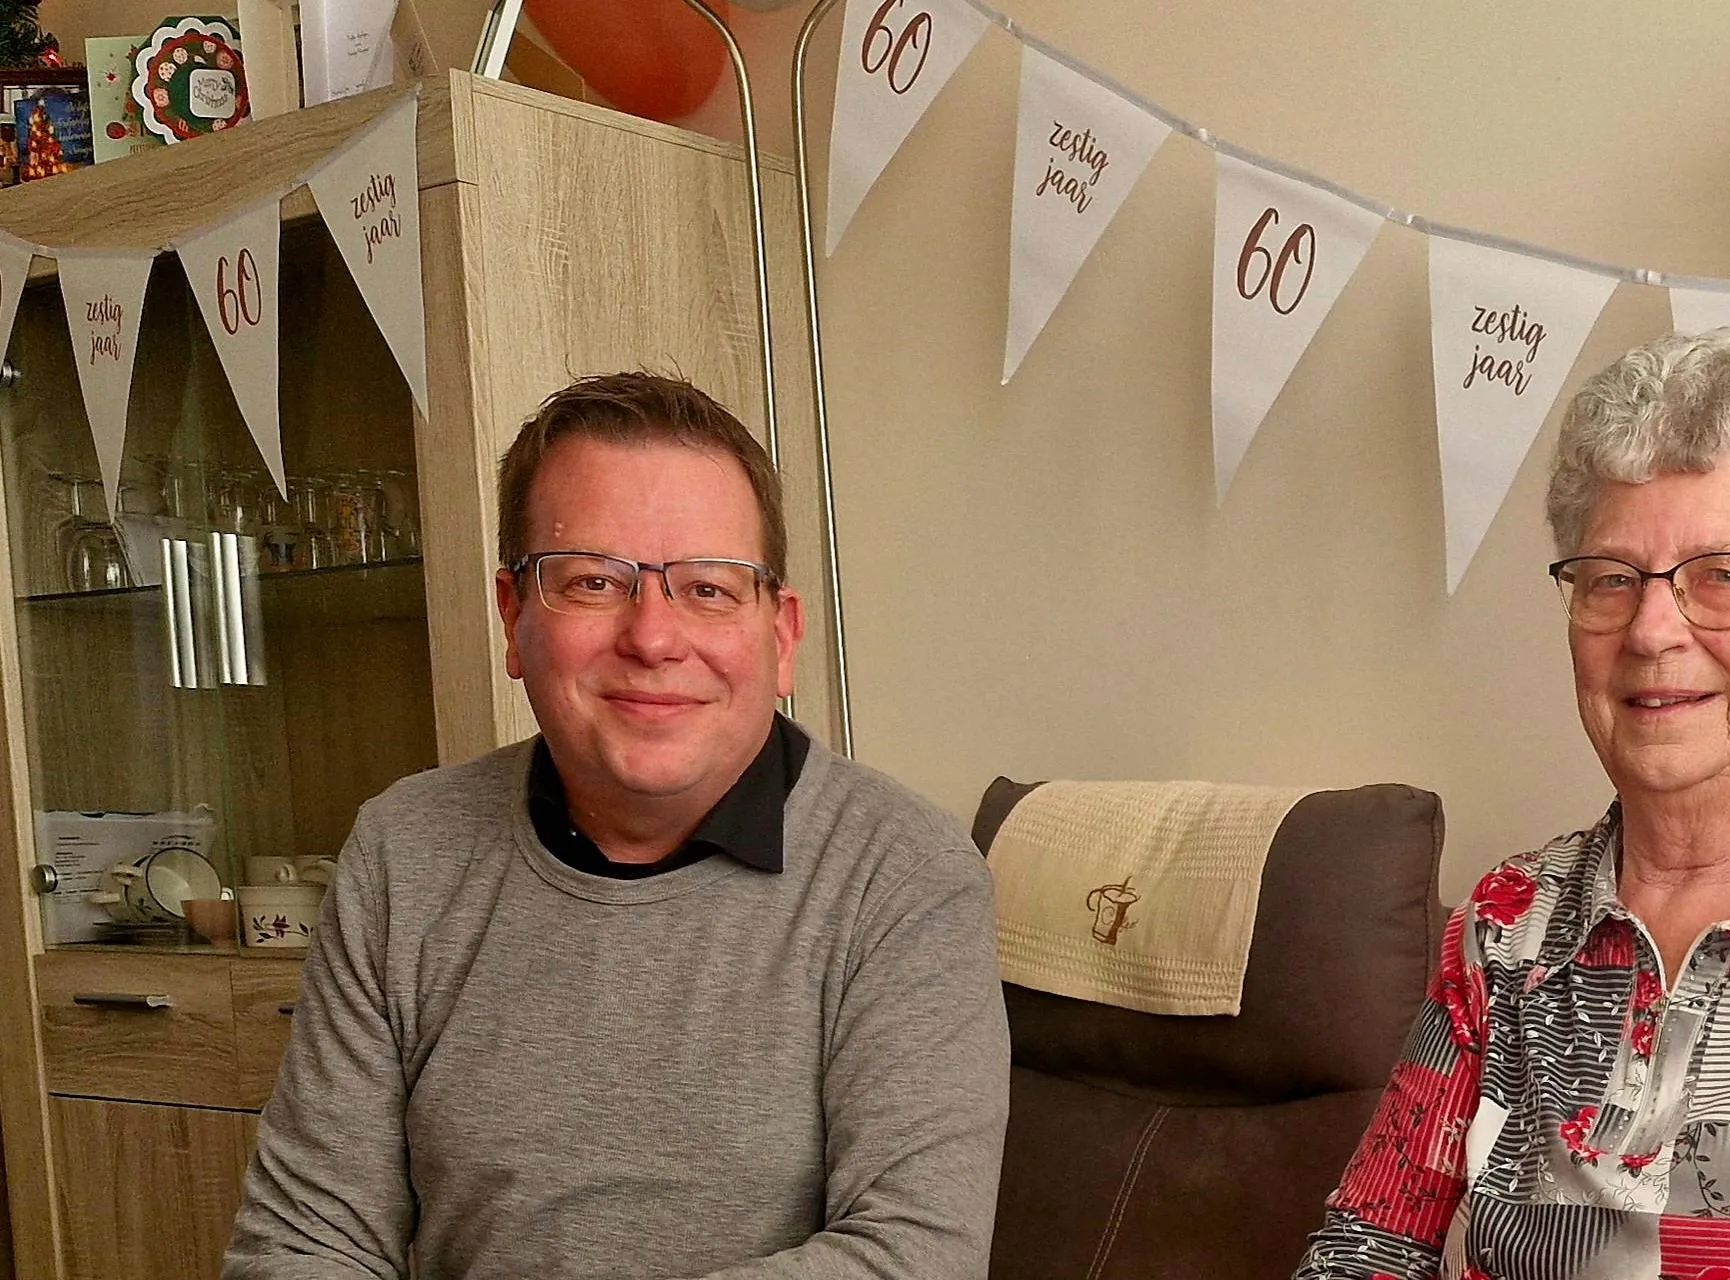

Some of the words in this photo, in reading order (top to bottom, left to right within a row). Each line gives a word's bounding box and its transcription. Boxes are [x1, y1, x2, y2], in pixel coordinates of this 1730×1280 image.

[861, 0, 932, 96] 60
[1048, 119, 1110, 187] zestig
[349, 173, 398, 221] zestig
[1035, 157, 1094, 215] jaar
[362, 209, 402, 266] jaar
[1236, 207, 1316, 316] 60
[85, 293, 124, 337] zestig
[216, 247, 263, 337] 60
[90, 331, 123, 367] jaar
[1471, 303, 1548, 365] zestig
[1462, 344, 1534, 398] jaar
